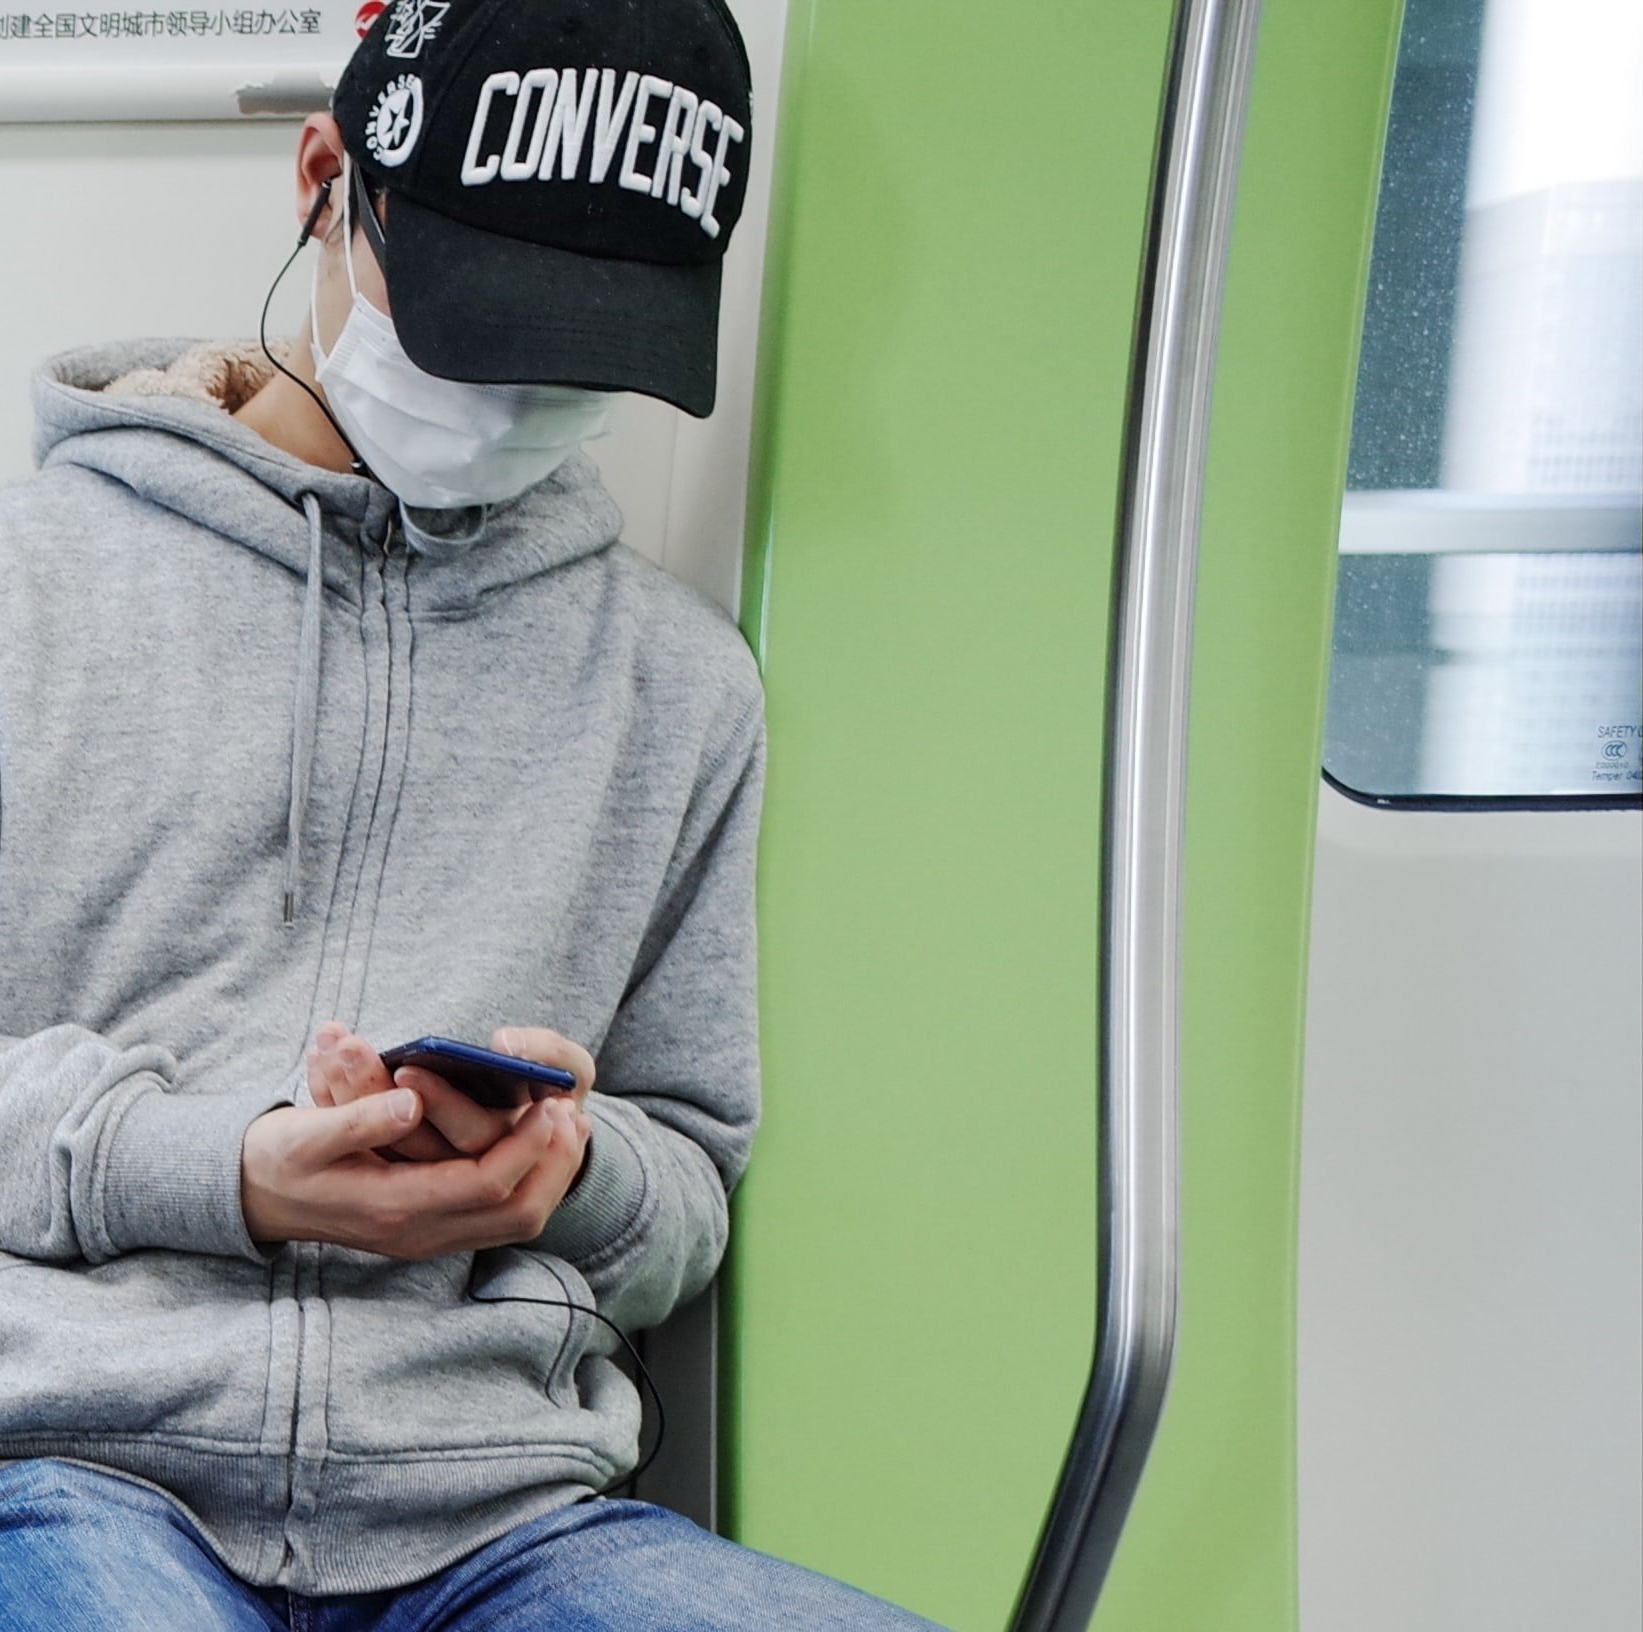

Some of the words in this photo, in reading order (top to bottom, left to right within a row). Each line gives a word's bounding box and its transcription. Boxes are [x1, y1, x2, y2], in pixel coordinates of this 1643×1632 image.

[365, 73, 416, 161] CONVERSE
[460, 67, 745, 240] CONVERSE
[1597, 725, 1637, 738] SAFETY
